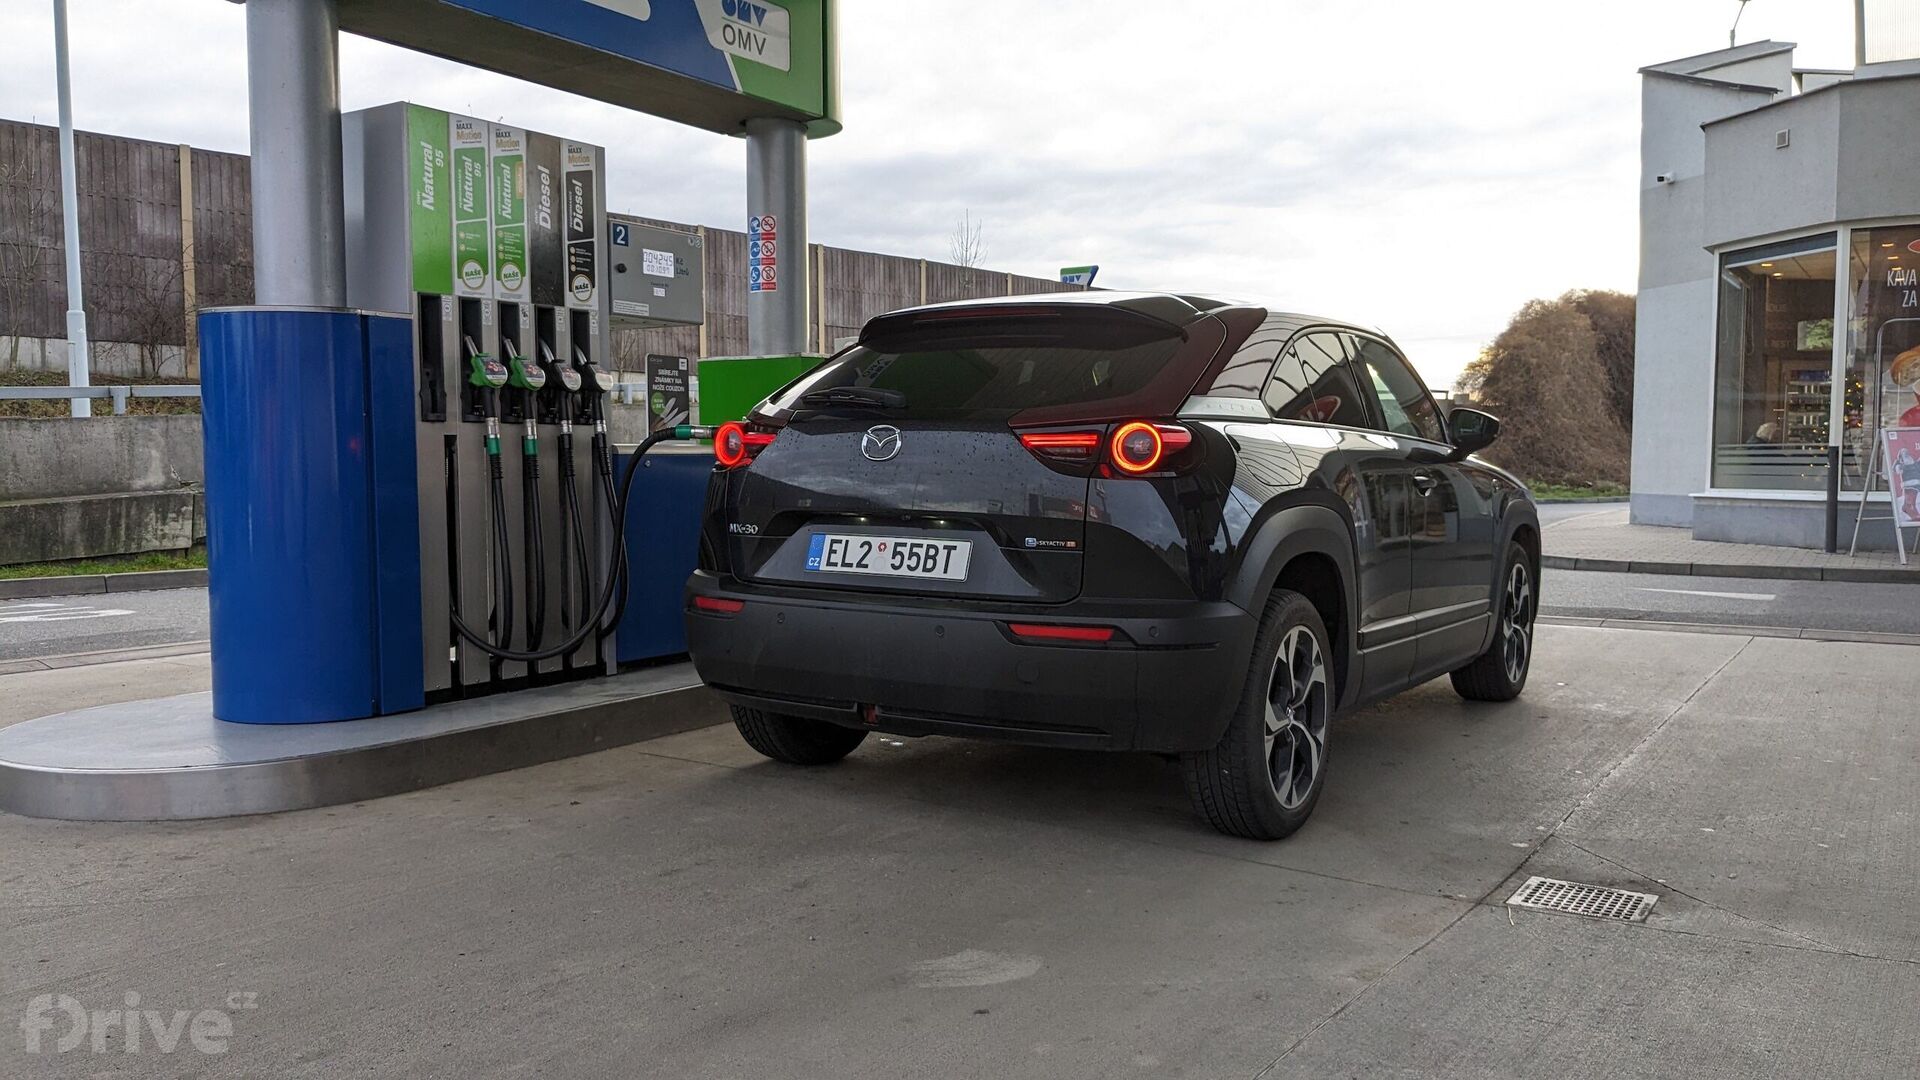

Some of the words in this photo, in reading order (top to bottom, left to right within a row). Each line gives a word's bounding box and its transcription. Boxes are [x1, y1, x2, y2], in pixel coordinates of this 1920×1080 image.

[722, 23, 767, 56] OMV
[420, 141, 434, 211] Natural
[435, 149, 444, 168] 95
[462, 155, 474, 213] Natural
[474, 162, 482, 177] 95
[500, 163, 512, 220] Natural
[537, 165, 551, 230] Diesel
[572, 179, 584, 233] Diesel
[616, 226, 627, 245] 2
[1902, 290, 1918, 307] ZA
[729, 523, 759, 535] MX-30
[808, 557, 820, 567] CZ
[825, 538, 873, 569] EL2
[890, 541, 958, 575] 55BT
